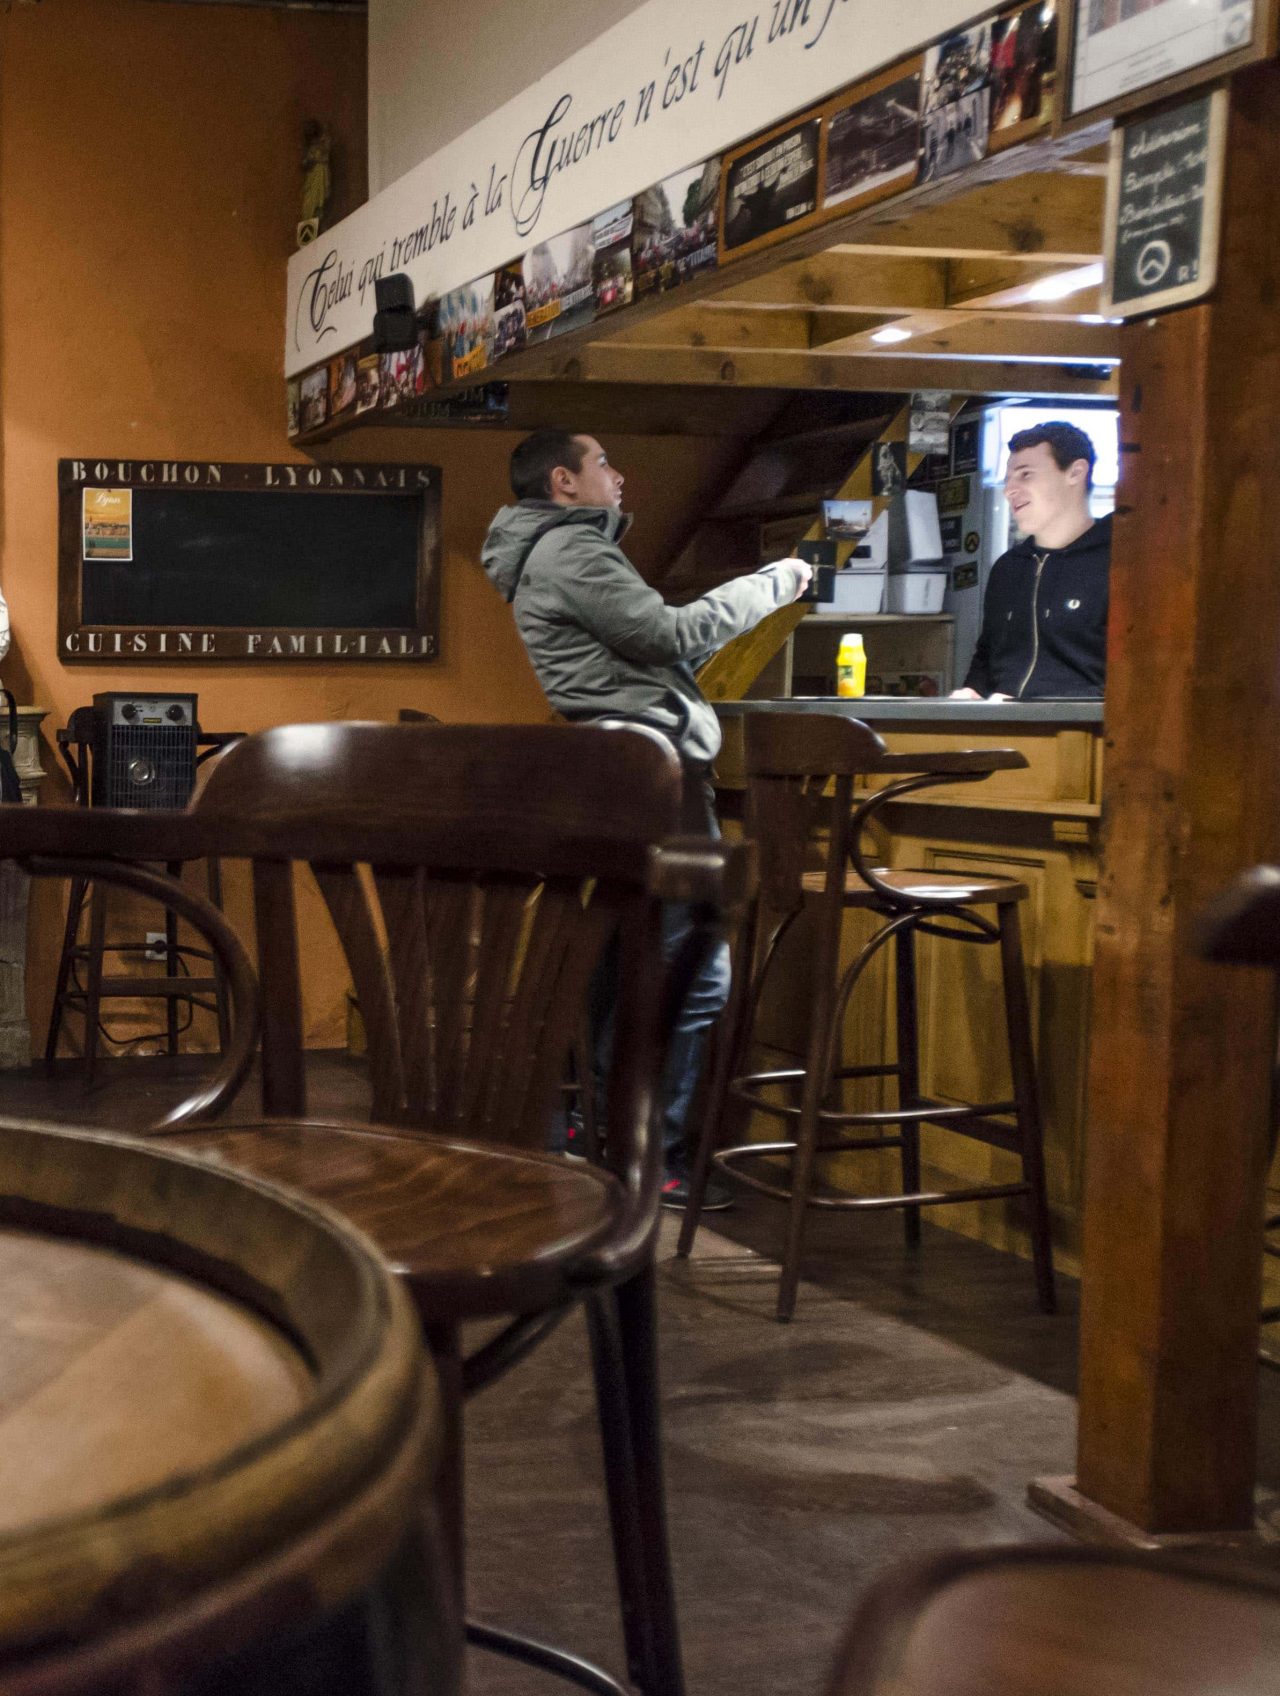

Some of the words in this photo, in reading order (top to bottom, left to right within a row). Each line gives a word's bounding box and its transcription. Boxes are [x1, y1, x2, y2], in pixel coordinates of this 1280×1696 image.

[296, 249, 355, 352] Celui
[358, 241, 384, 306] qui
[389, 191, 457, 272] tremble
[462, 180, 480, 231] à
[484, 163, 508, 217] la
[510, 93, 626, 237] Guerre
[72, 461, 222, 484] BOUCHON
[265, 465, 431, 489] LYONNAIS
[65, 633, 217, 654] CUISINE
[247, 633, 435, 655] FAMILIALE
